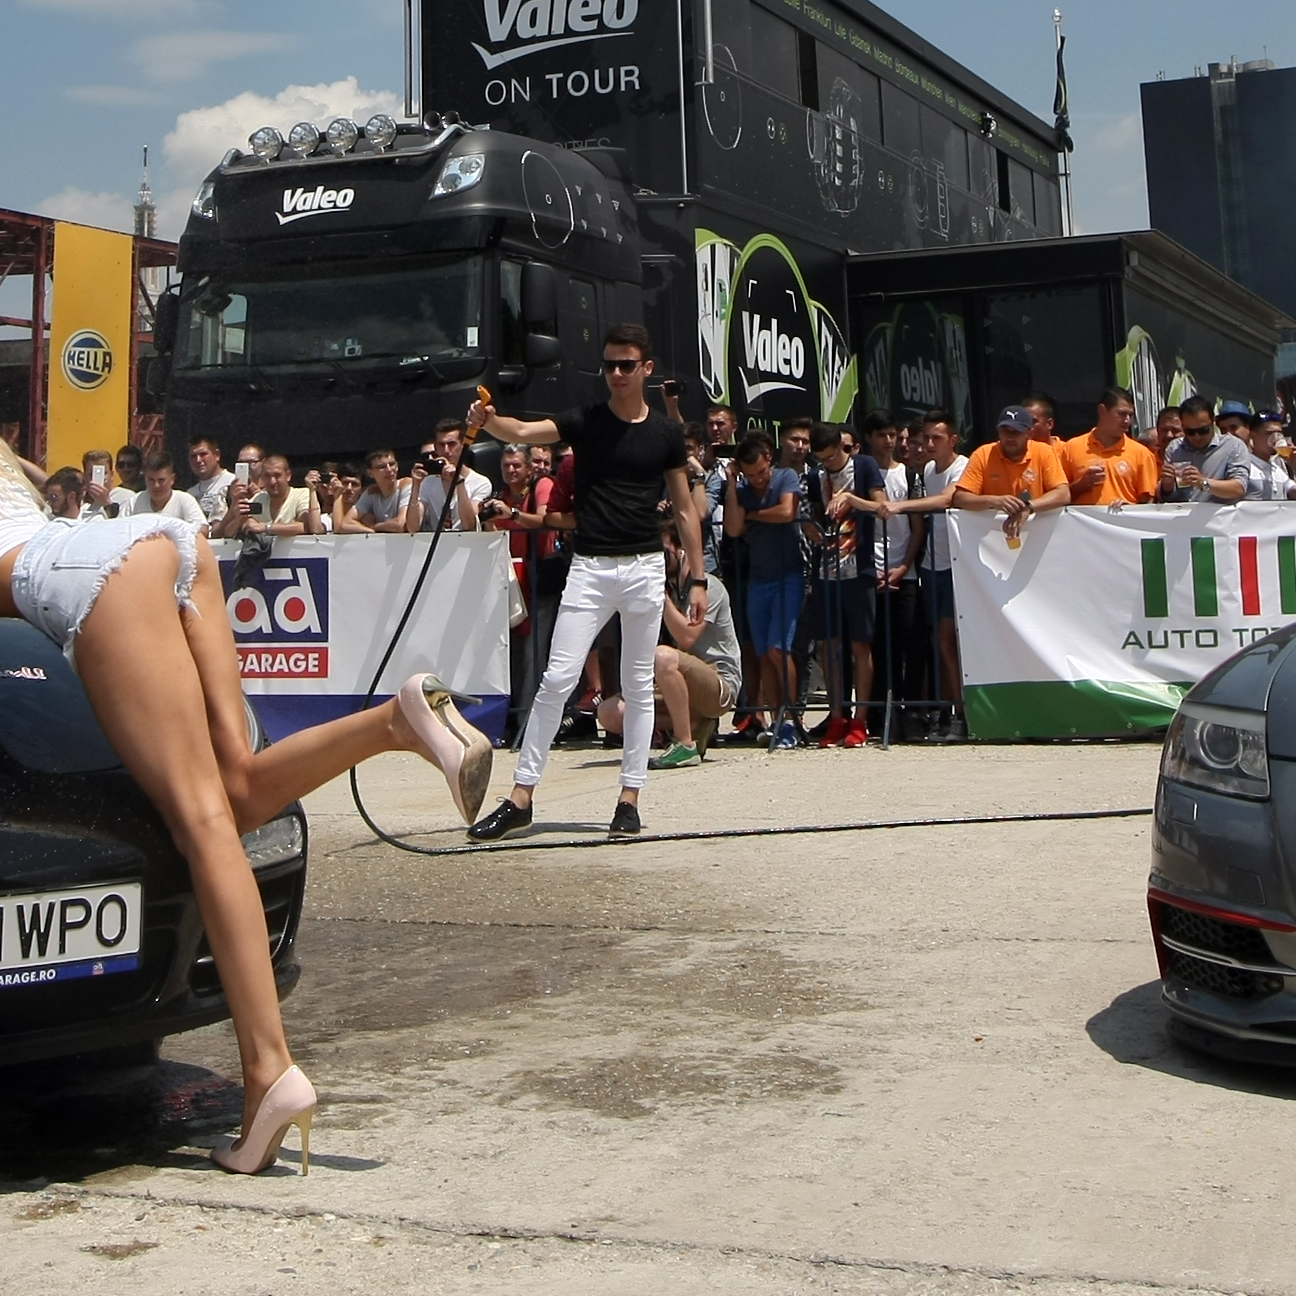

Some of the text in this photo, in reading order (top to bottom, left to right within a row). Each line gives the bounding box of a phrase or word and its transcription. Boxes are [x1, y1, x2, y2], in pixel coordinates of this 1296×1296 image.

[485, 65, 640, 106] ON TOUR
[284, 186, 355, 212] Valeo
[742, 310, 804, 379] Valeo
[67, 350, 112, 374] HELLA
[1121, 629, 1219, 649] AUTO
